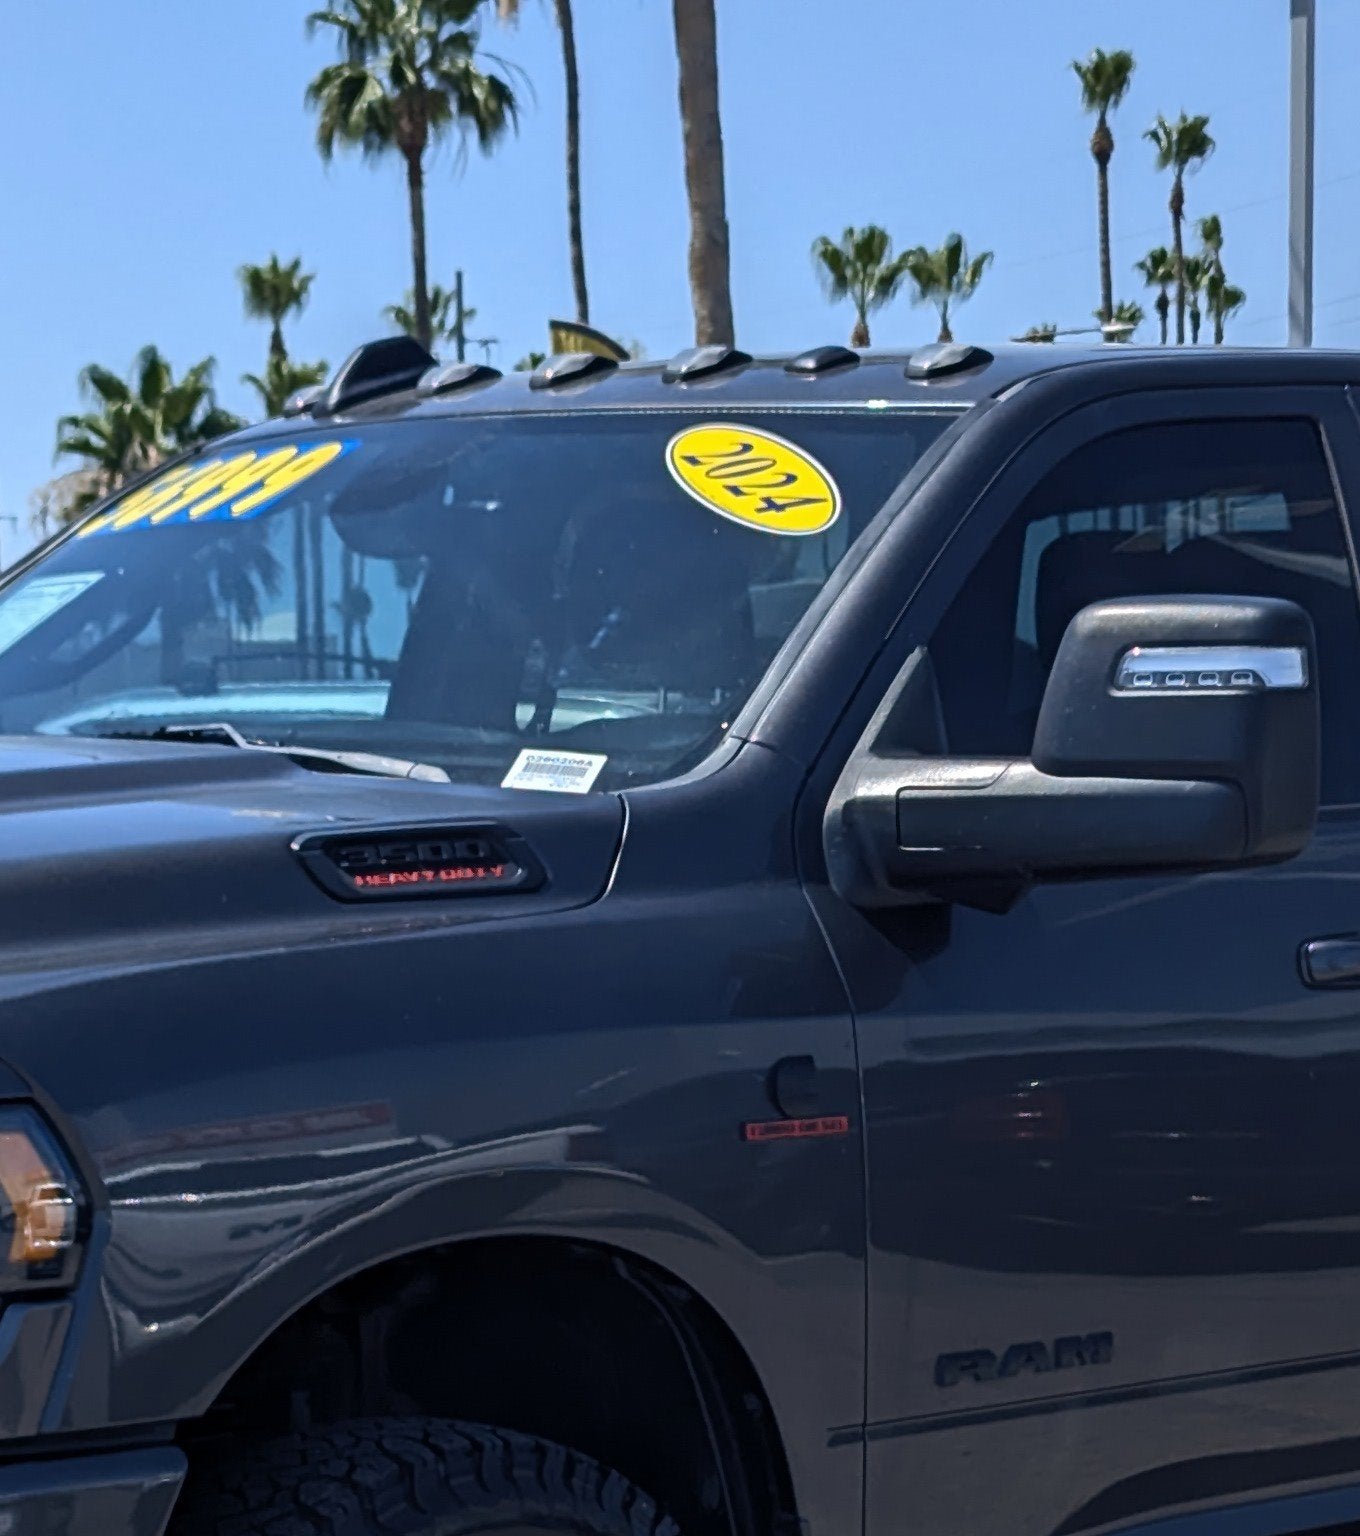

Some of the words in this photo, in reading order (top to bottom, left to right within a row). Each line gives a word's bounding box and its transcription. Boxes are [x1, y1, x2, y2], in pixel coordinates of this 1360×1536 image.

[679, 442, 828, 513] 2024
[339, 839, 488, 867] 3500
[353, 868, 436, 887] HEAVY
[438, 864, 505, 883] DUTY
[933, 1330, 1114, 1389] RAM
